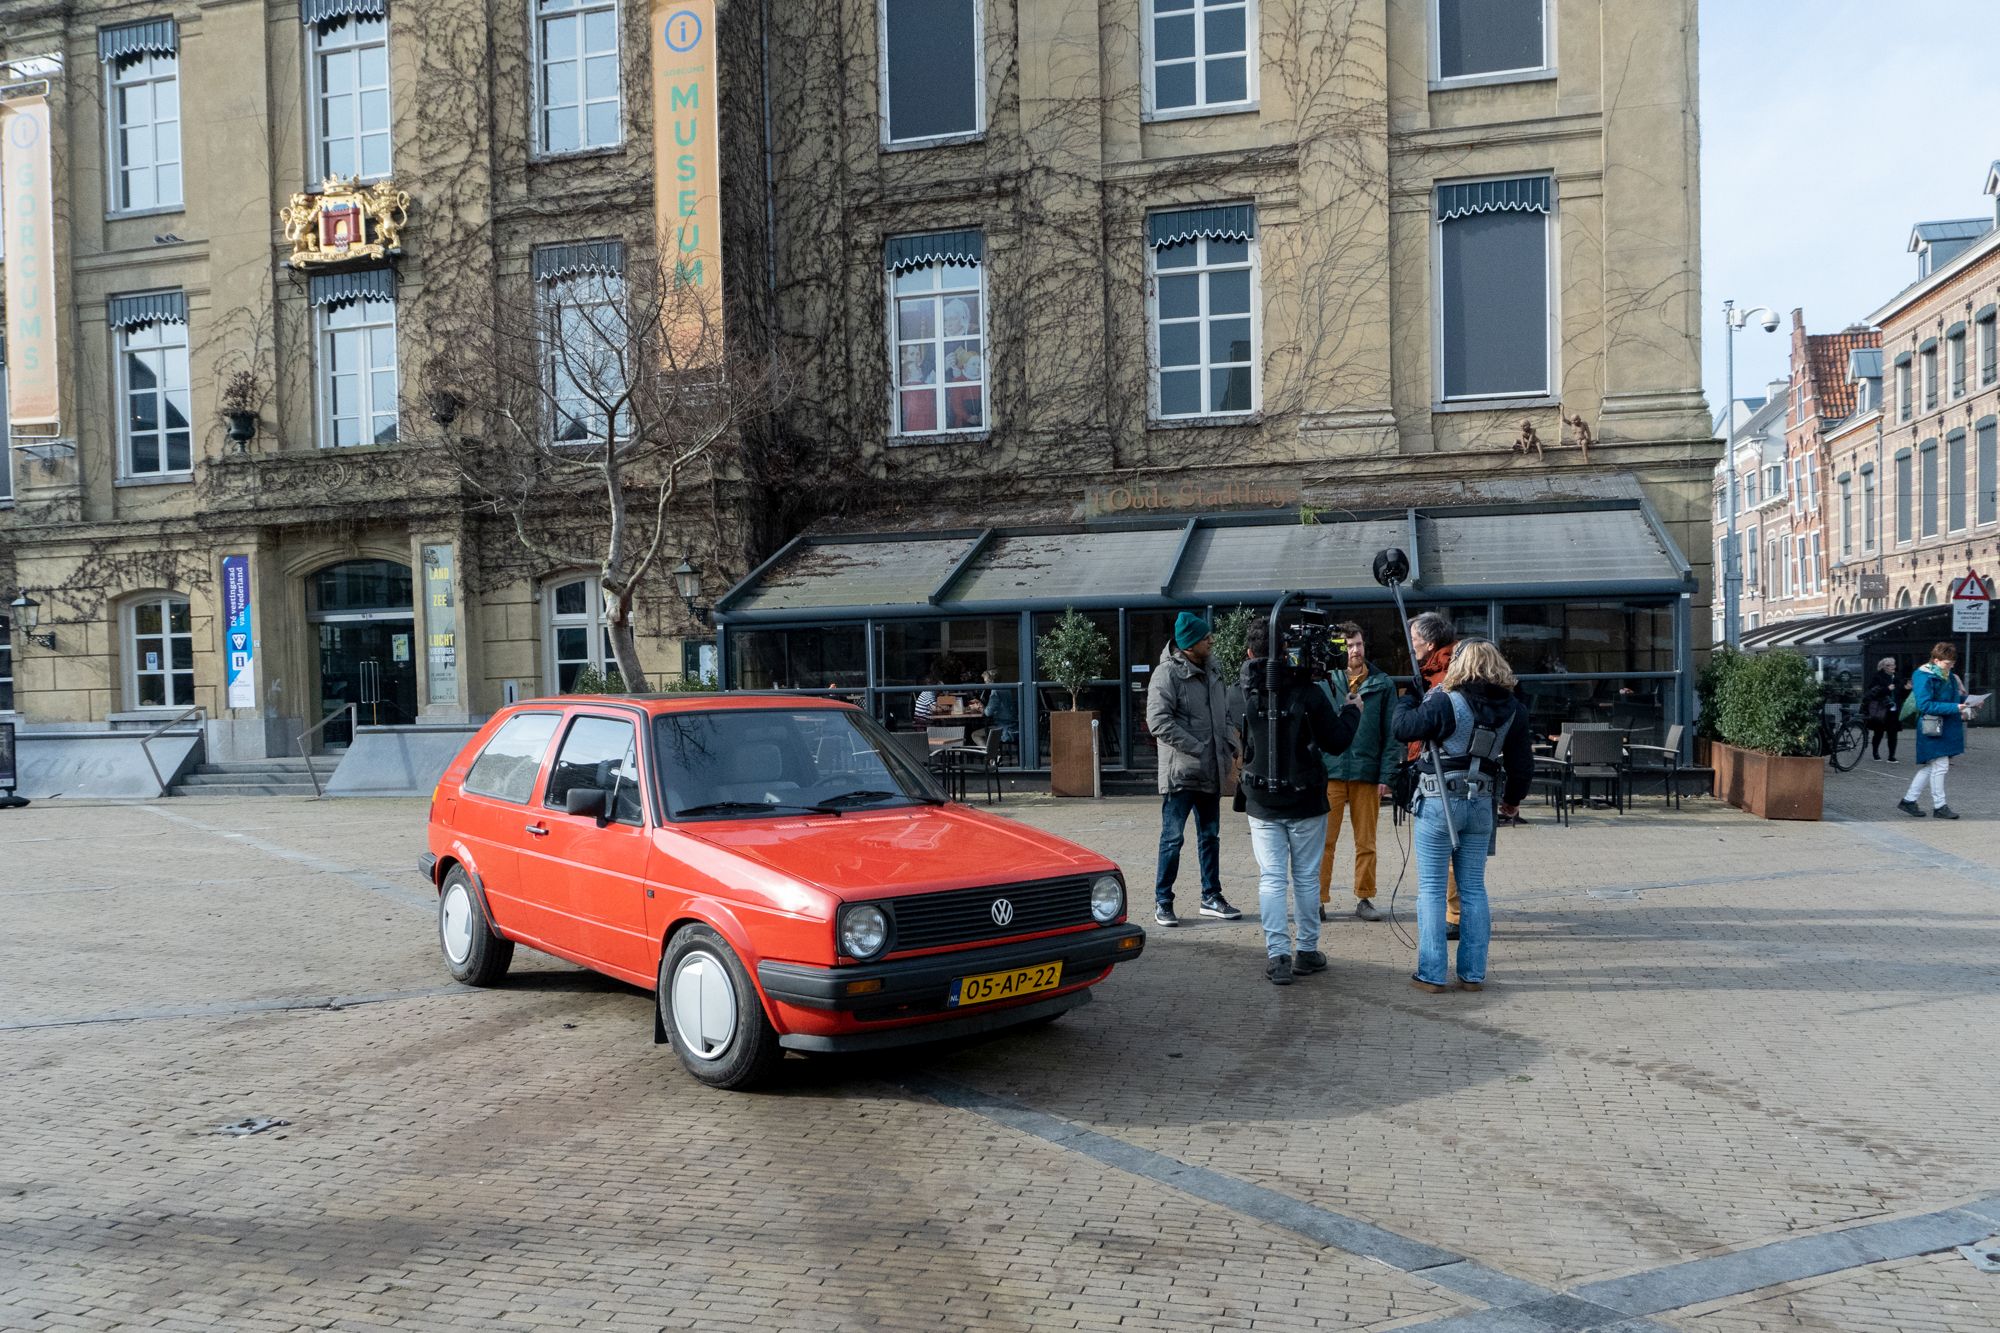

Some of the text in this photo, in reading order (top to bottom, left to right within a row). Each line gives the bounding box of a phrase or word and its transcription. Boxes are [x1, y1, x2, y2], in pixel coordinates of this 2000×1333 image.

[671, 82, 704, 289] MUSEUM
[16, 163, 42, 374] GORCUMS
[236, 567, 245, 609] Nederland
[429, 567, 449, 580] LAND
[228, 567, 237, 627] Dé vestingstad
[433, 593, 448, 607] ZEE
[429, 633, 454, 646] LUCHT
[991, 899, 1013, 926] VW
[966, 966, 1056, 999] 05-AP-22
